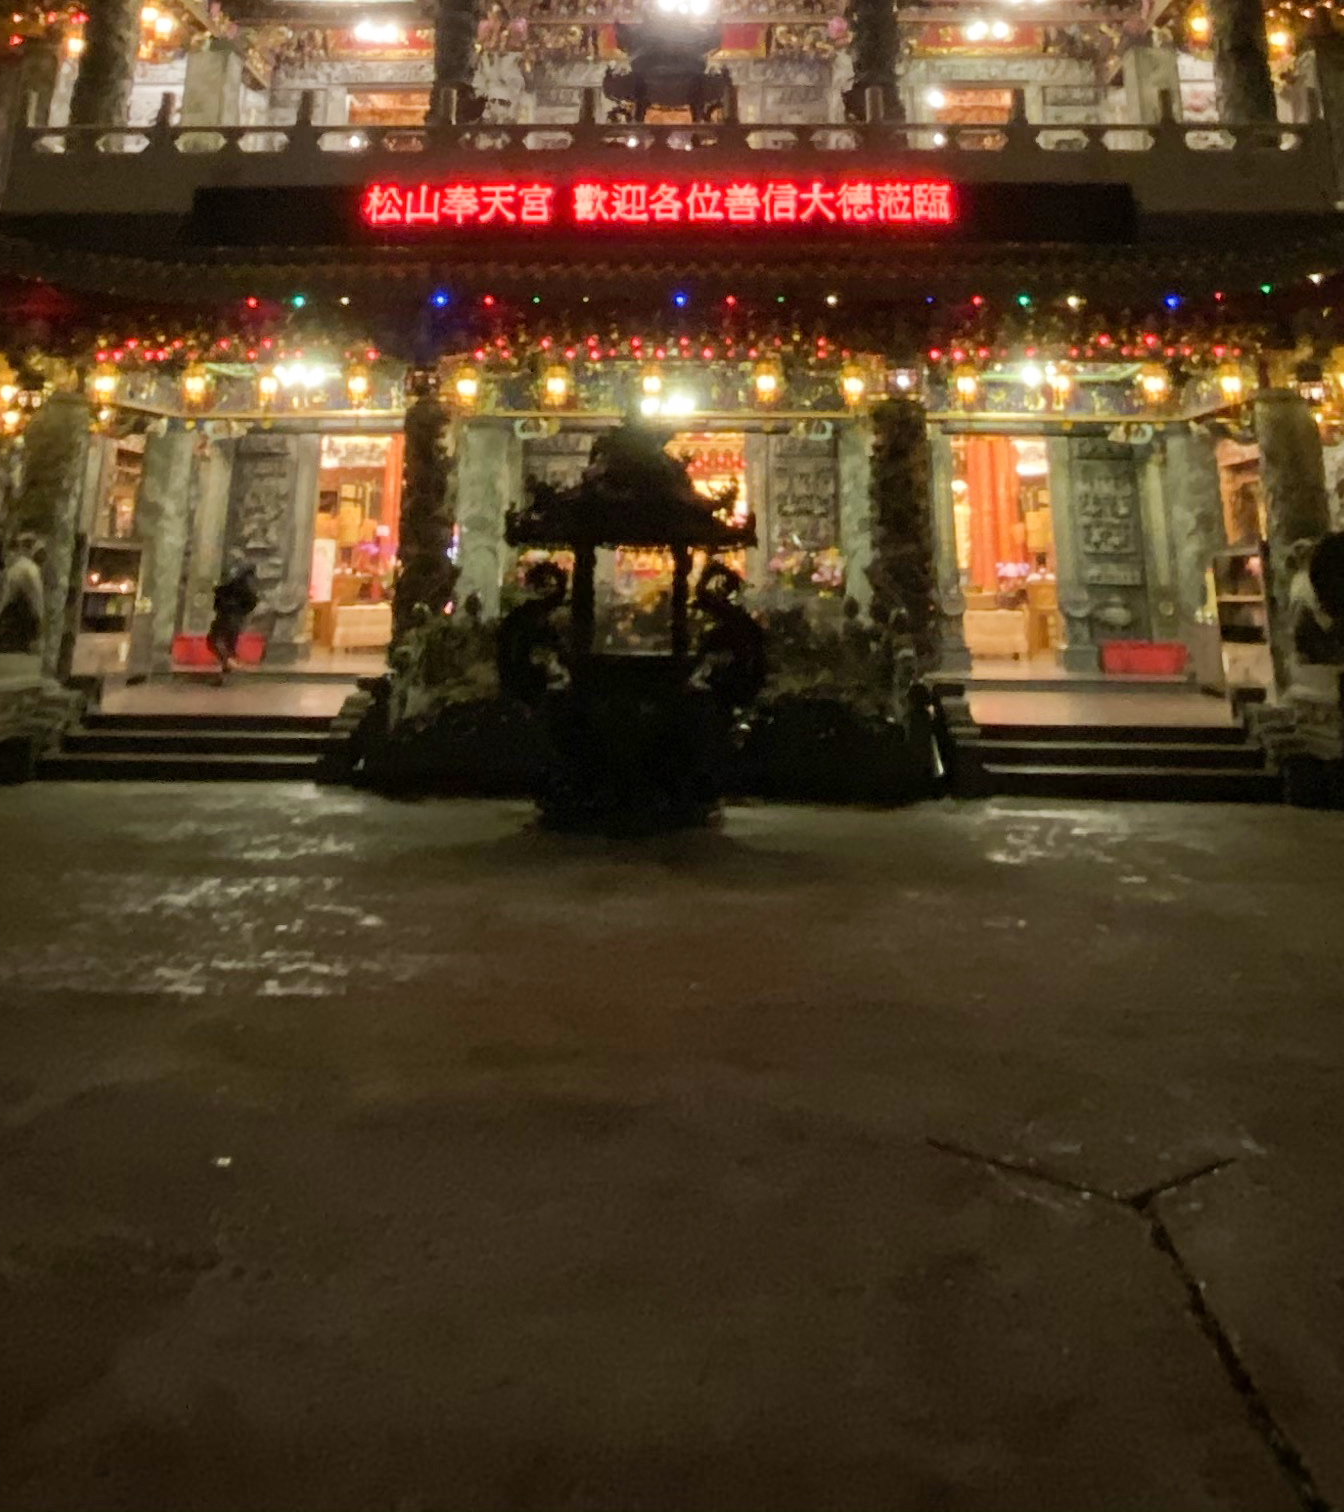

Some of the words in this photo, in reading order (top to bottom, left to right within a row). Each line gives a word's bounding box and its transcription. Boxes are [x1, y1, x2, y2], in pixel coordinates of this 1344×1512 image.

[365, 184, 554, 224] 松山奉天宮
[573, 183, 952, 223] 歡迎各位善信大德蒞臨
